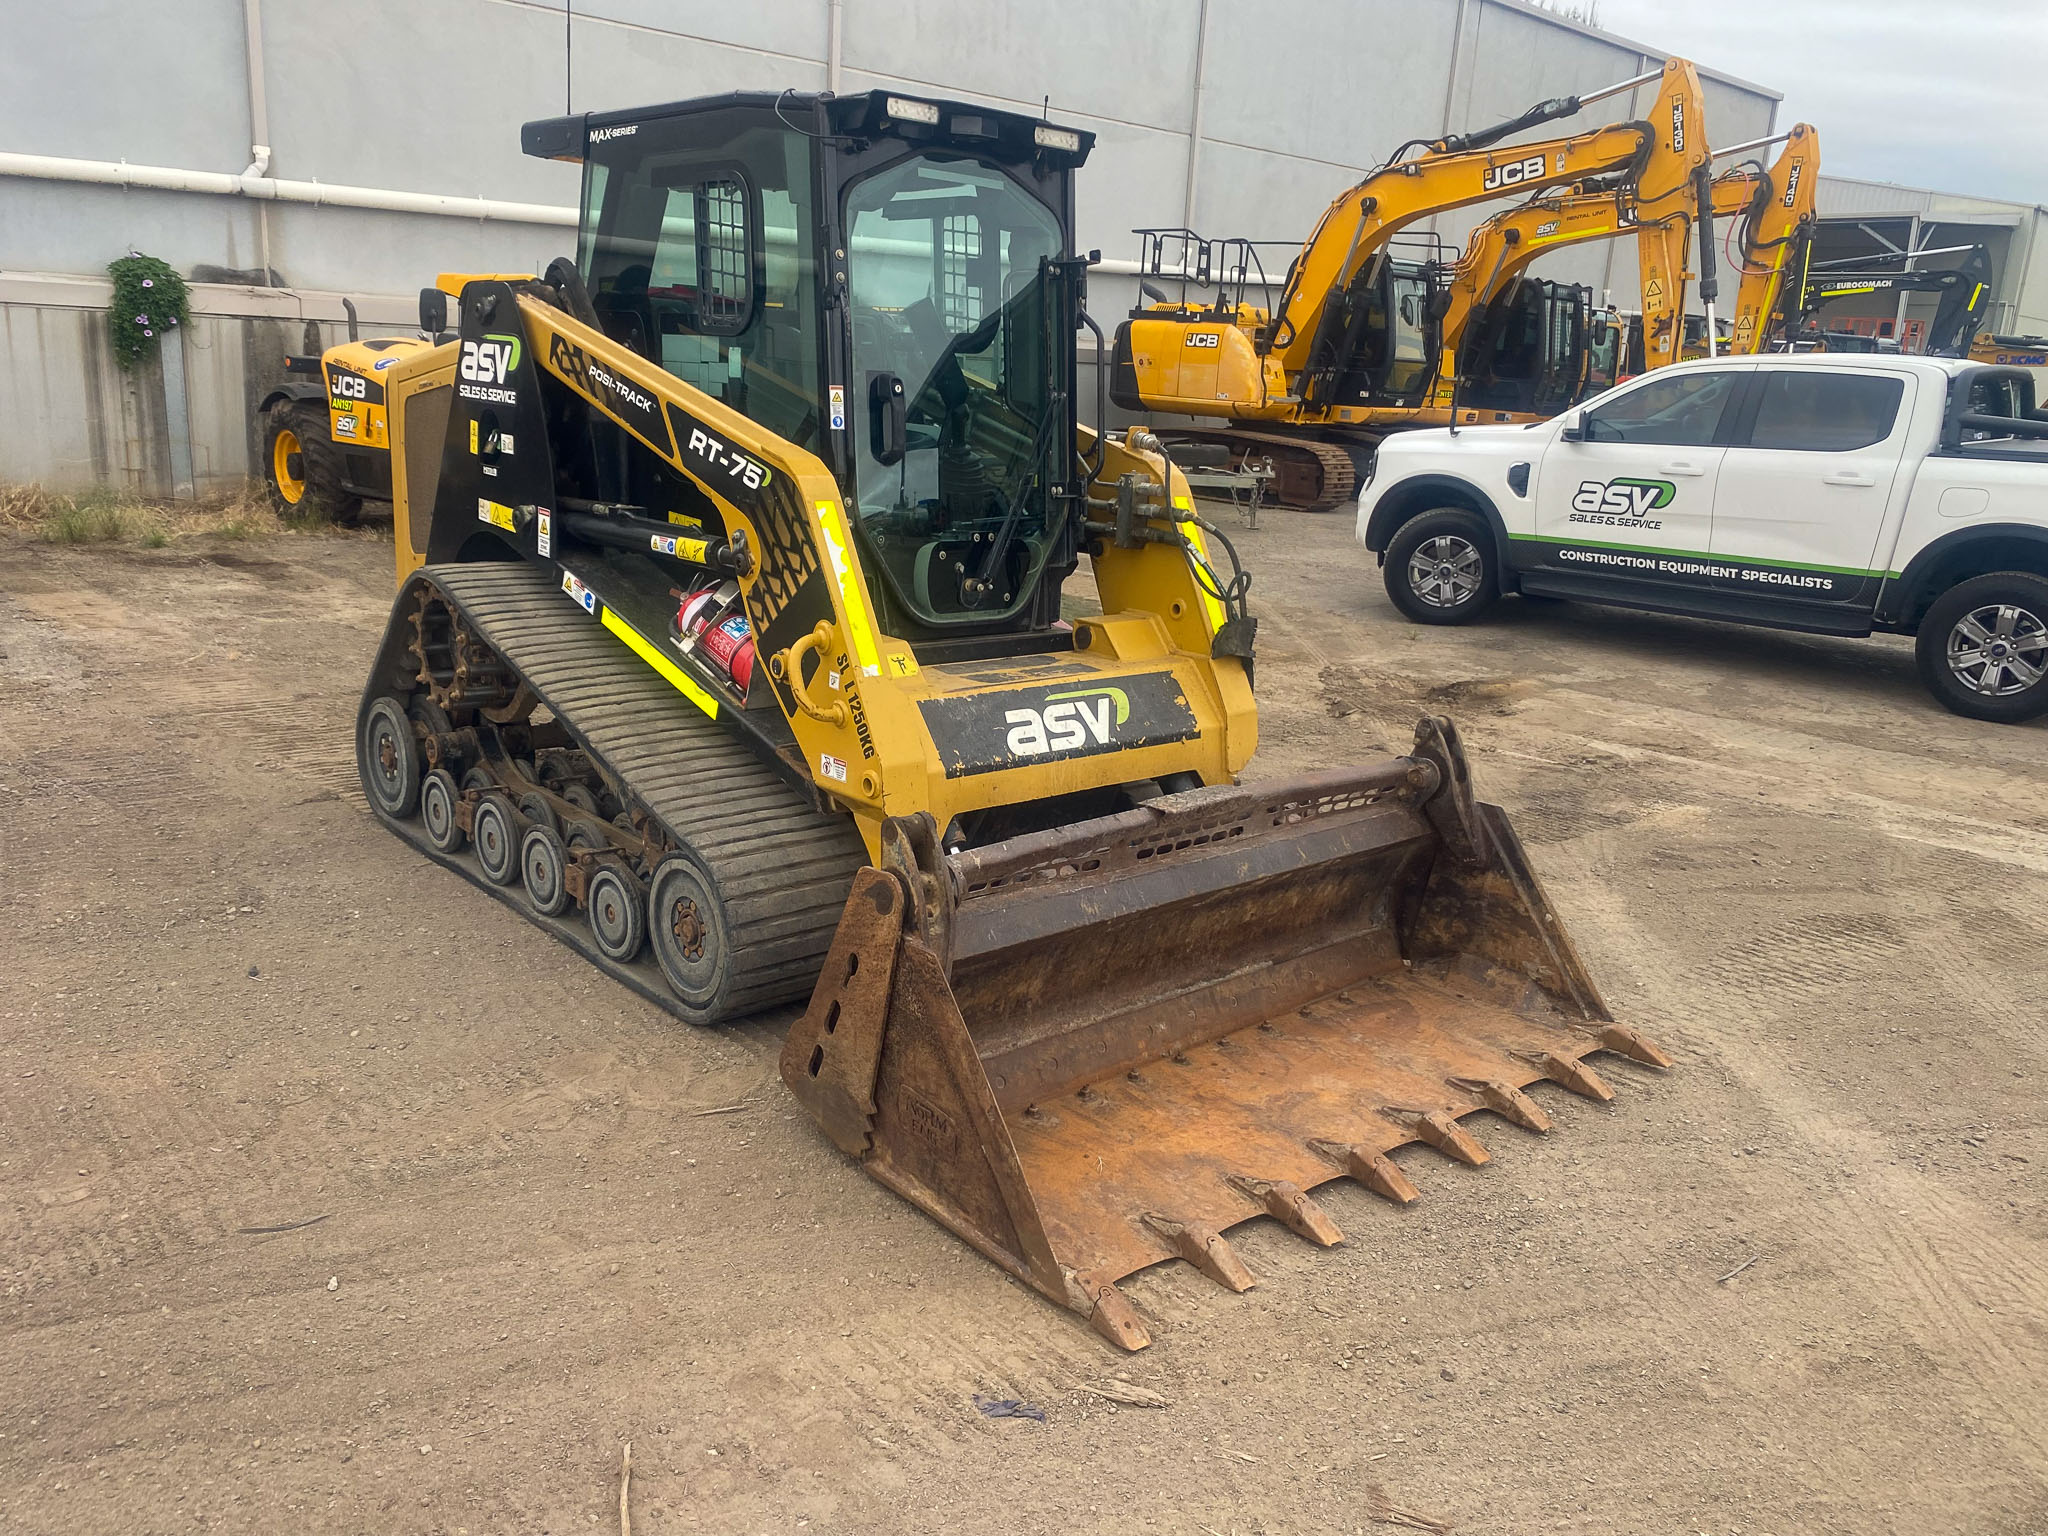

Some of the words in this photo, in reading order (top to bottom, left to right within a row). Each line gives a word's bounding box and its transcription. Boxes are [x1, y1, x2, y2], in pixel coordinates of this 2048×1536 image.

[1484, 156, 1545, 189] JCB
[1836, 280, 1893, 290] EUROCOMACH
[1186, 333, 1219, 348] JCB
[332, 374, 366, 399] JCB
[480, 387, 488, 400] &
[487, 388, 517, 404] SERVICE
[588, 365, 652, 413] POSI-TRACK
[332, 398, 353, 411] AN197
[688, 427, 763, 490] RT-75
[1604, 516, 1616, 526] &
[1616, 517, 1663, 530] SERVICE
[1558, 549, 1656, 570] CONSTRUCTION
[1658, 560, 1739, 579] EQUIPMENT
[1741, 569, 1833, 590] SPECIALISTS
[847, 692, 876, 761] 1250KG
